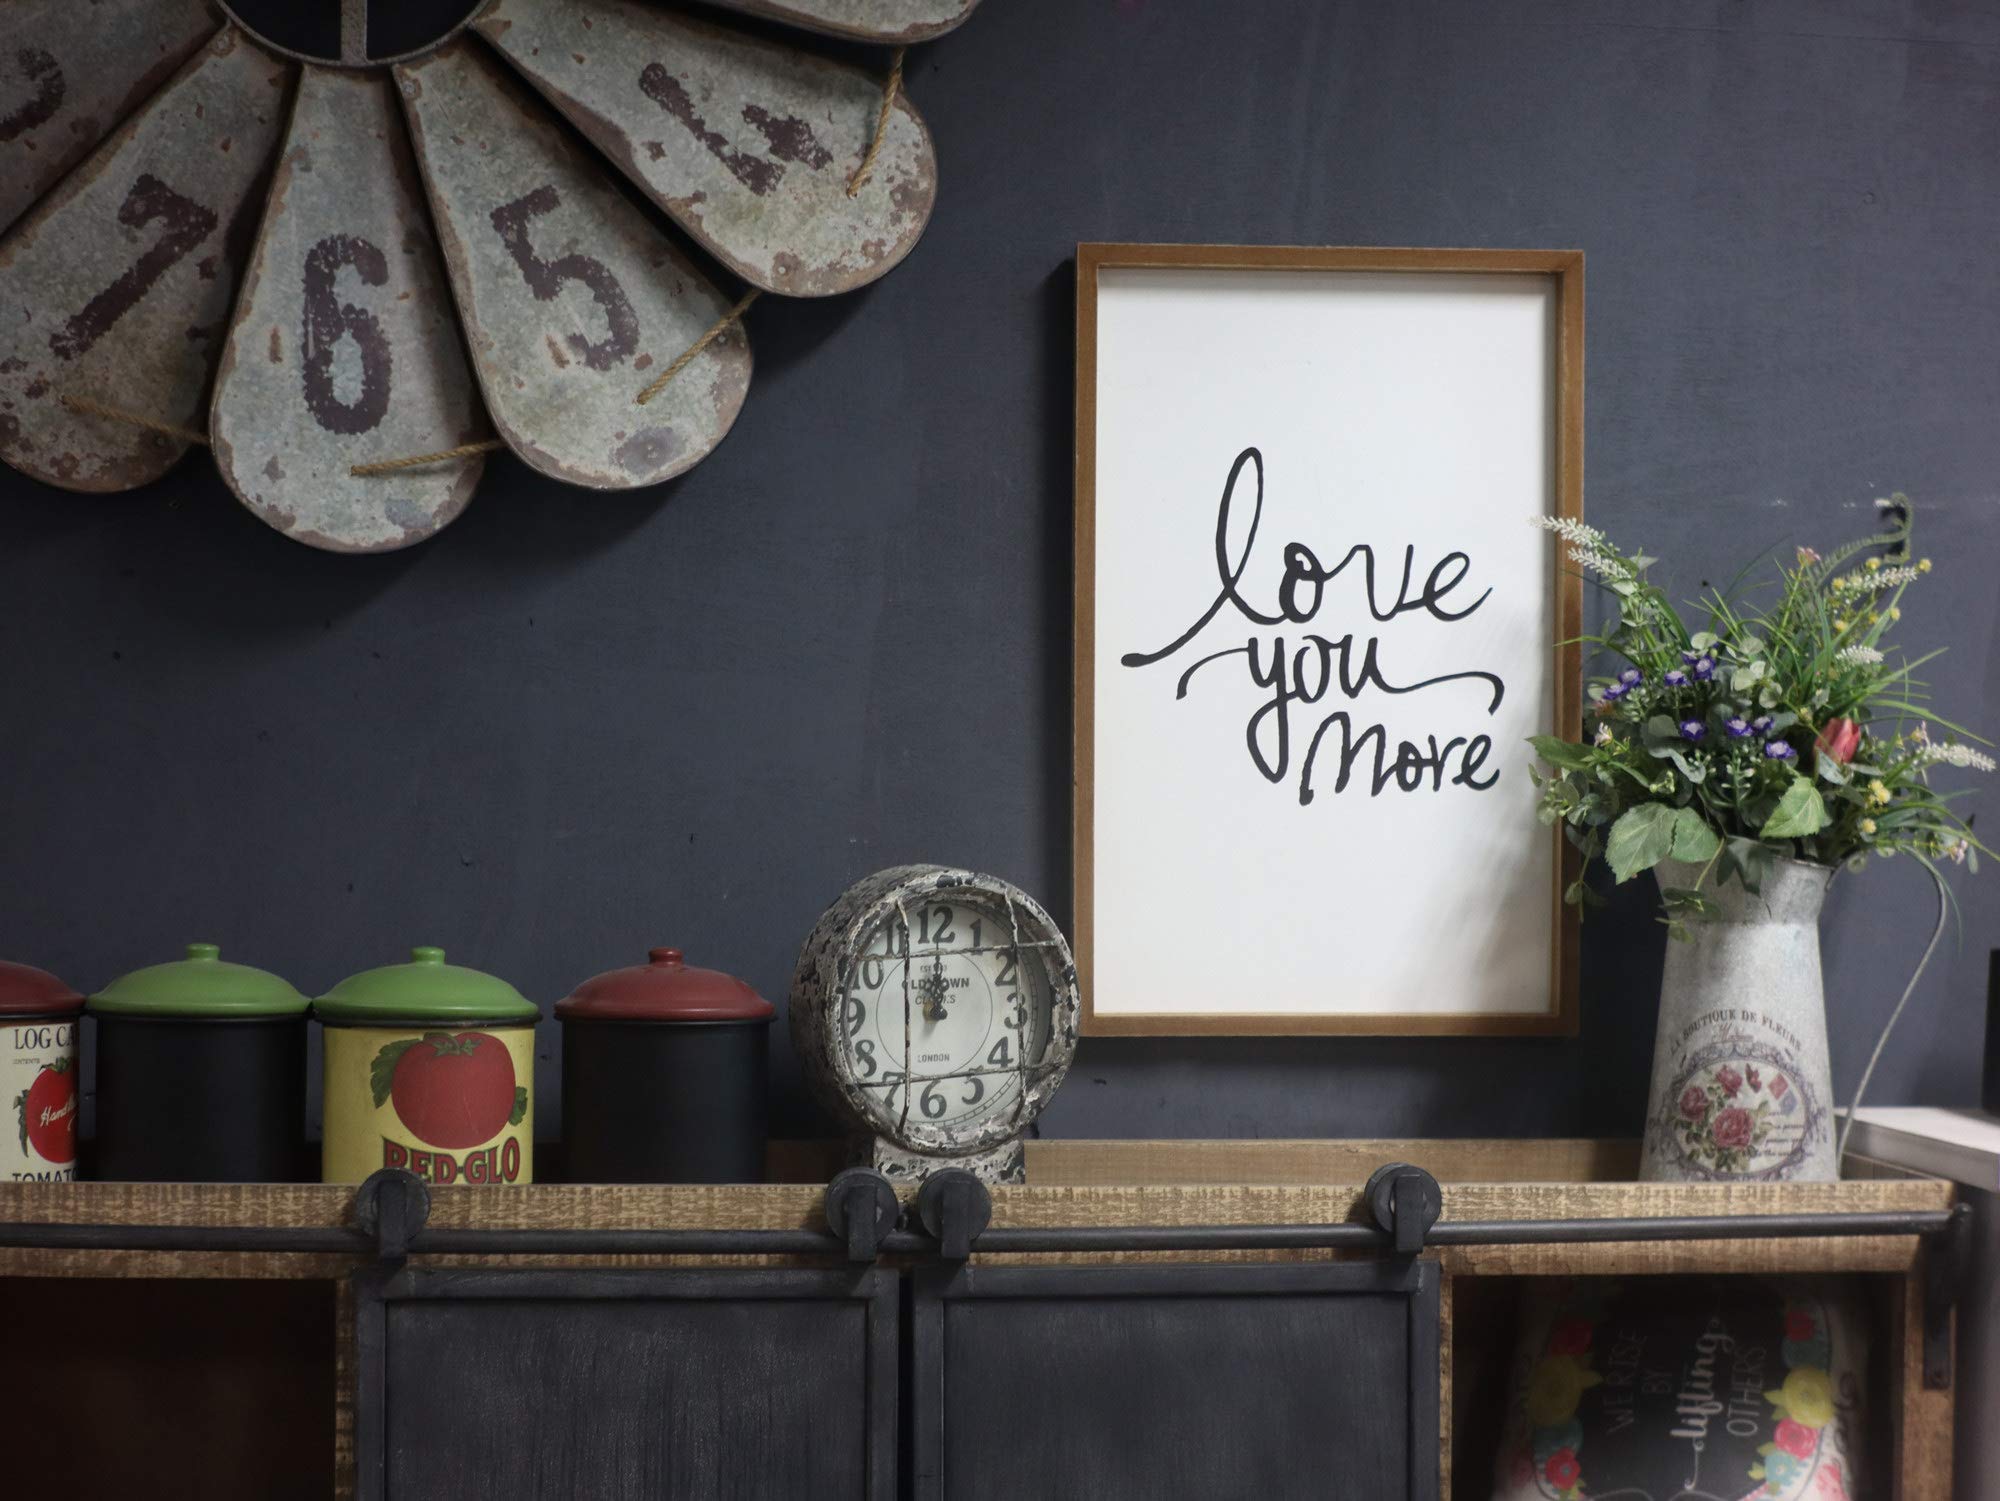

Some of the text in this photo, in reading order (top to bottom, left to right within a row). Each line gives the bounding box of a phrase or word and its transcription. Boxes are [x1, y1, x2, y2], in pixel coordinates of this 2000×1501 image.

[49, 174, 218, 360] 7
[489, 185, 639, 371] 5
[302, 233, 392, 435] 6
[1121, 447, 1493, 668] love
[1176, 634, 1505, 784] you
[916, 906, 955, 944] 12
[969, 919, 983, 955] 1
[902, 977, 970, 990] LDWN
[995, 951, 1017, 986] 2
[847, 997, 866, 1038] 9
[915, 994, 956, 1005] CLS
[1004, 992, 1028, 1029] 3
[1741, 1010, 1757, 1023] DE
[14, 1027, 52, 1050] LOG
[987, 1037, 1013, 1068] 4
[854, 1039, 877, 1078] 8
[918, 1054, 950, 1063] LONDON
[882, 1071, 905, 1110] 7
[920, 1078, 947, 1119] 6
[962, 1065, 984, 1105] 5
[381, 1135, 521, 1184] RED-GLO
[1670, 1330, 1735, 1438] lifting
[1726, 1344, 1767, 1437] OTHERS
